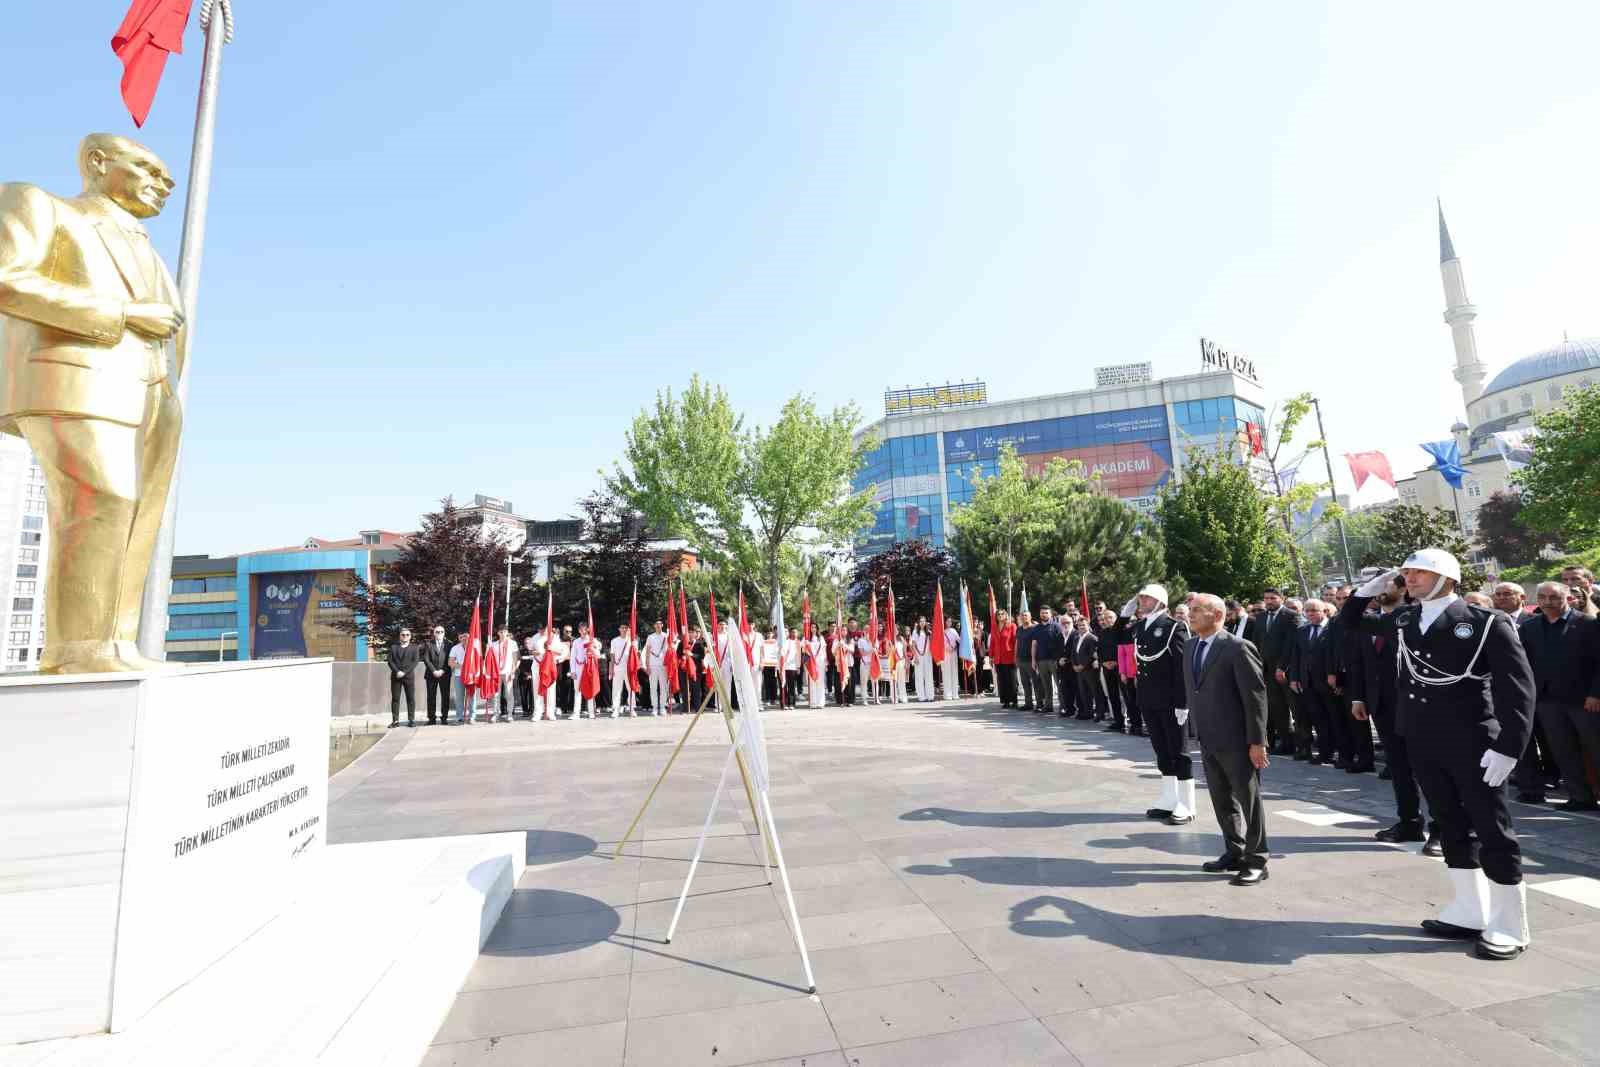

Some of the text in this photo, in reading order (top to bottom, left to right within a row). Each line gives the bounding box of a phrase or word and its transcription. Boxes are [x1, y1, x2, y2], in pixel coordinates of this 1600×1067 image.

[1217, 348, 1257, 381] PLAZA
[1092, 455, 1151, 473] AKADEMİ
[221, 736, 290, 769] TÜRK MİLLETİ ZEKİDİR
[207, 763, 295, 809] TÜRK MİLLETİ ÇALIŞKANDIR
[174, 836, 199, 859] TÜRK
[200, 813, 245, 848] MİLLETİNİN
[245, 797, 279, 826] KARAKTERİ
